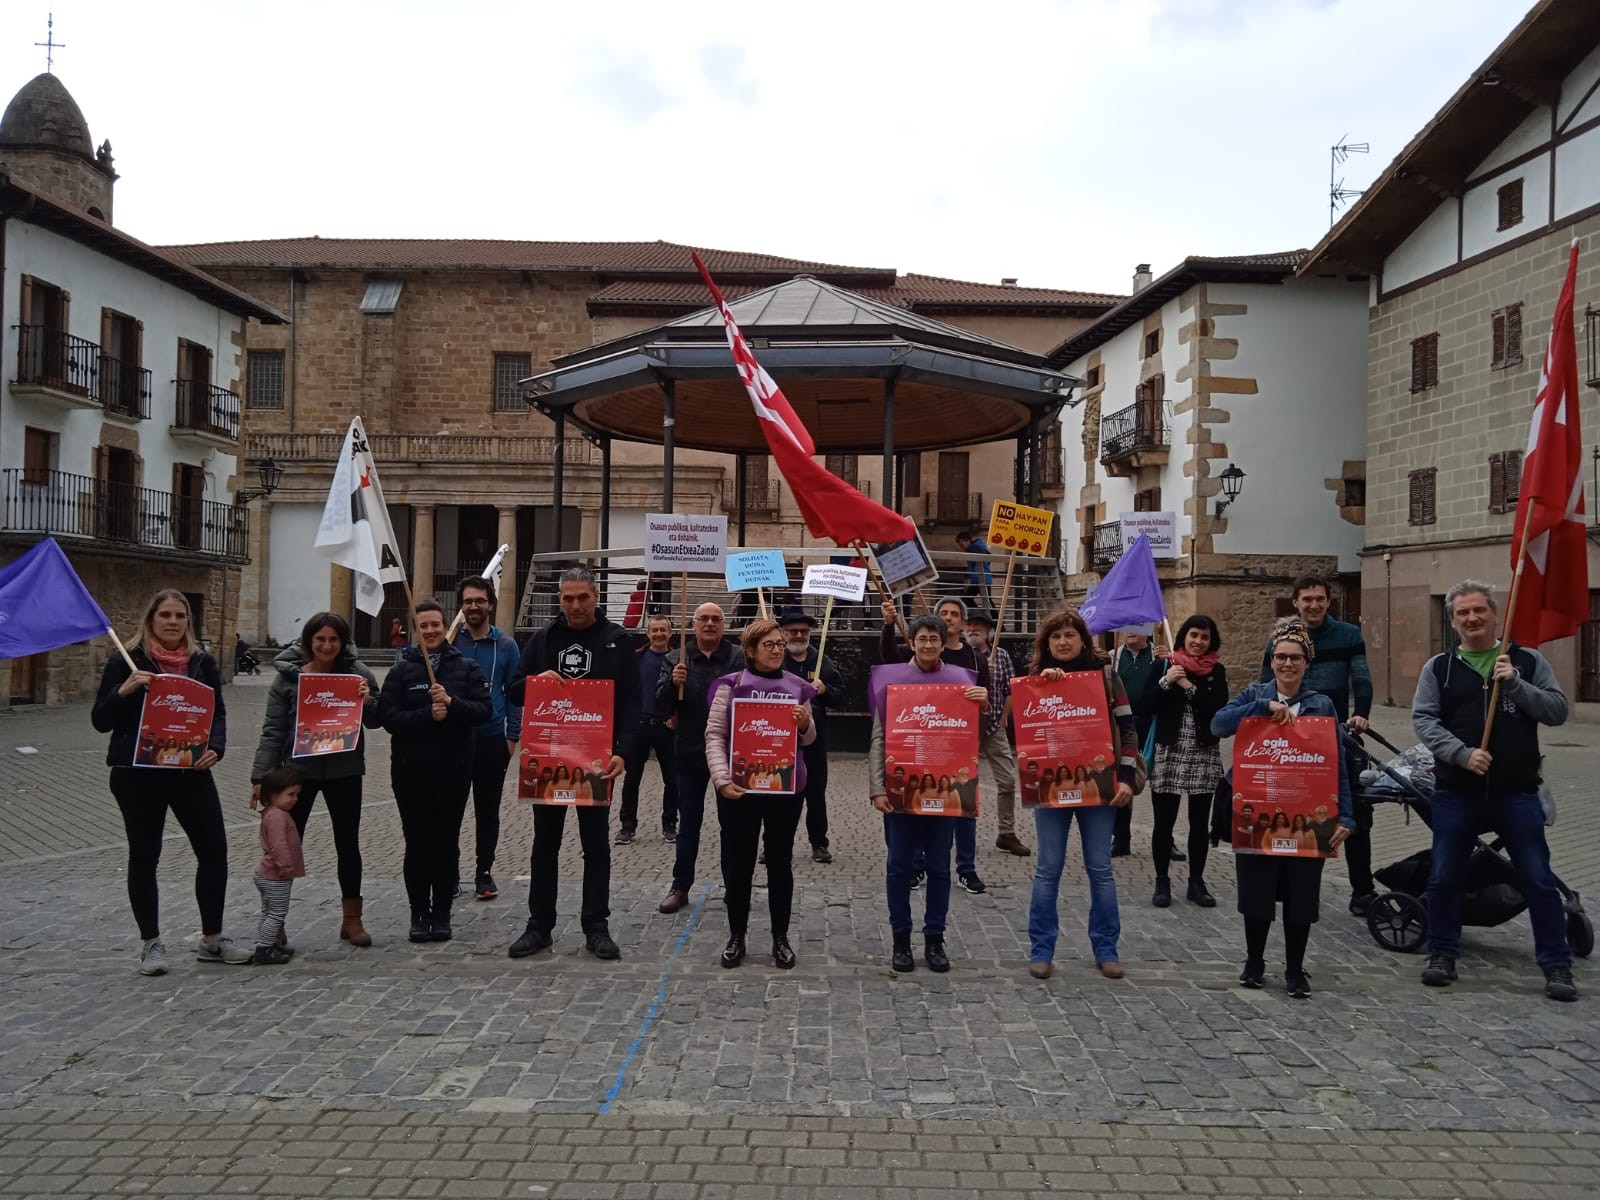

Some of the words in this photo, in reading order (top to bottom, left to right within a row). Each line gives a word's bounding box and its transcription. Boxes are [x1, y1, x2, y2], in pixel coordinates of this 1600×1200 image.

[998, 506, 1014, 518] NO
[1016, 512, 1031, 520] HAY
[1032, 516, 1048, 525] PAN
[1014, 524, 1046, 536] CHORIZO
[652, 544, 719, 556] #OsasunEtxeaZaindu
[551, 698, 572, 708] egin
[1040, 694, 1062, 706] egin
[912, 704, 936, 714] egin
[1056, 706, 1096, 720] posible
[564, 712, 602, 722] posible
[928, 718, 968, 728] posible
[1262, 738, 1288, 750] egin
[1280, 752, 1326, 764] posible
